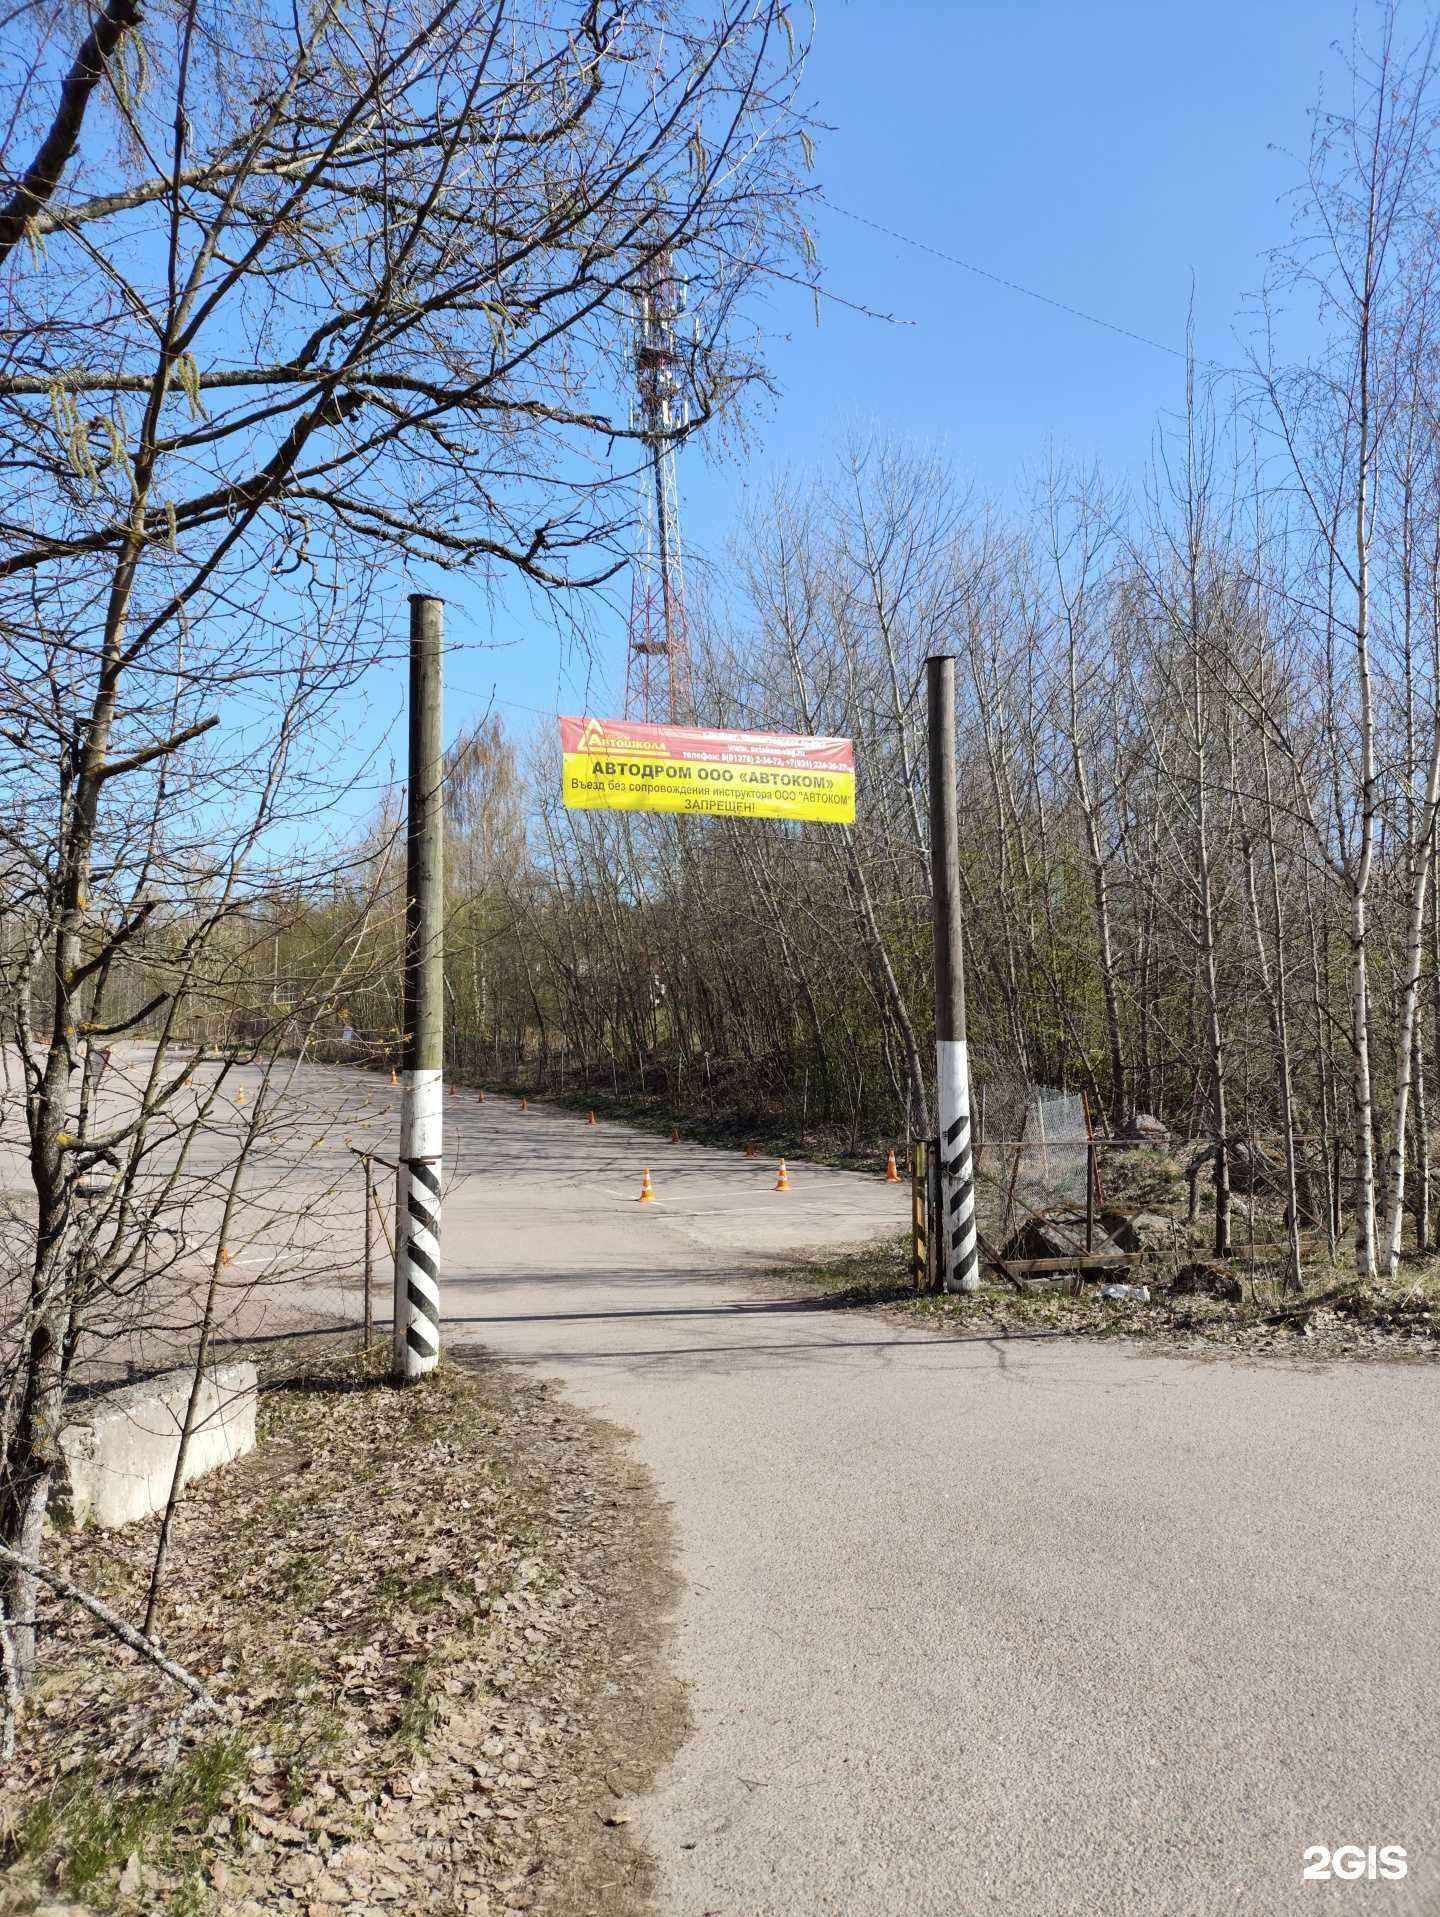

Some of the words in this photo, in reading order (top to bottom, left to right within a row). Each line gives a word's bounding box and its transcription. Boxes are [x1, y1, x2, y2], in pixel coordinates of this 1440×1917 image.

[592, 761, 692, 779] АВТОДРОМ
[697, 768, 733, 782] ООО
[740, 771, 834, 789] «АВТОКОМ»
[571, 778, 606, 793] Въезд
[608, 780, 626, 791] без
[628, 783, 710, 796] сопровождения
[713, 788, 773, 800] инструктора
[774, 790, 796, 801] ООО
[684, 798, 755, 813] ЗАПРЕЩЕН!
